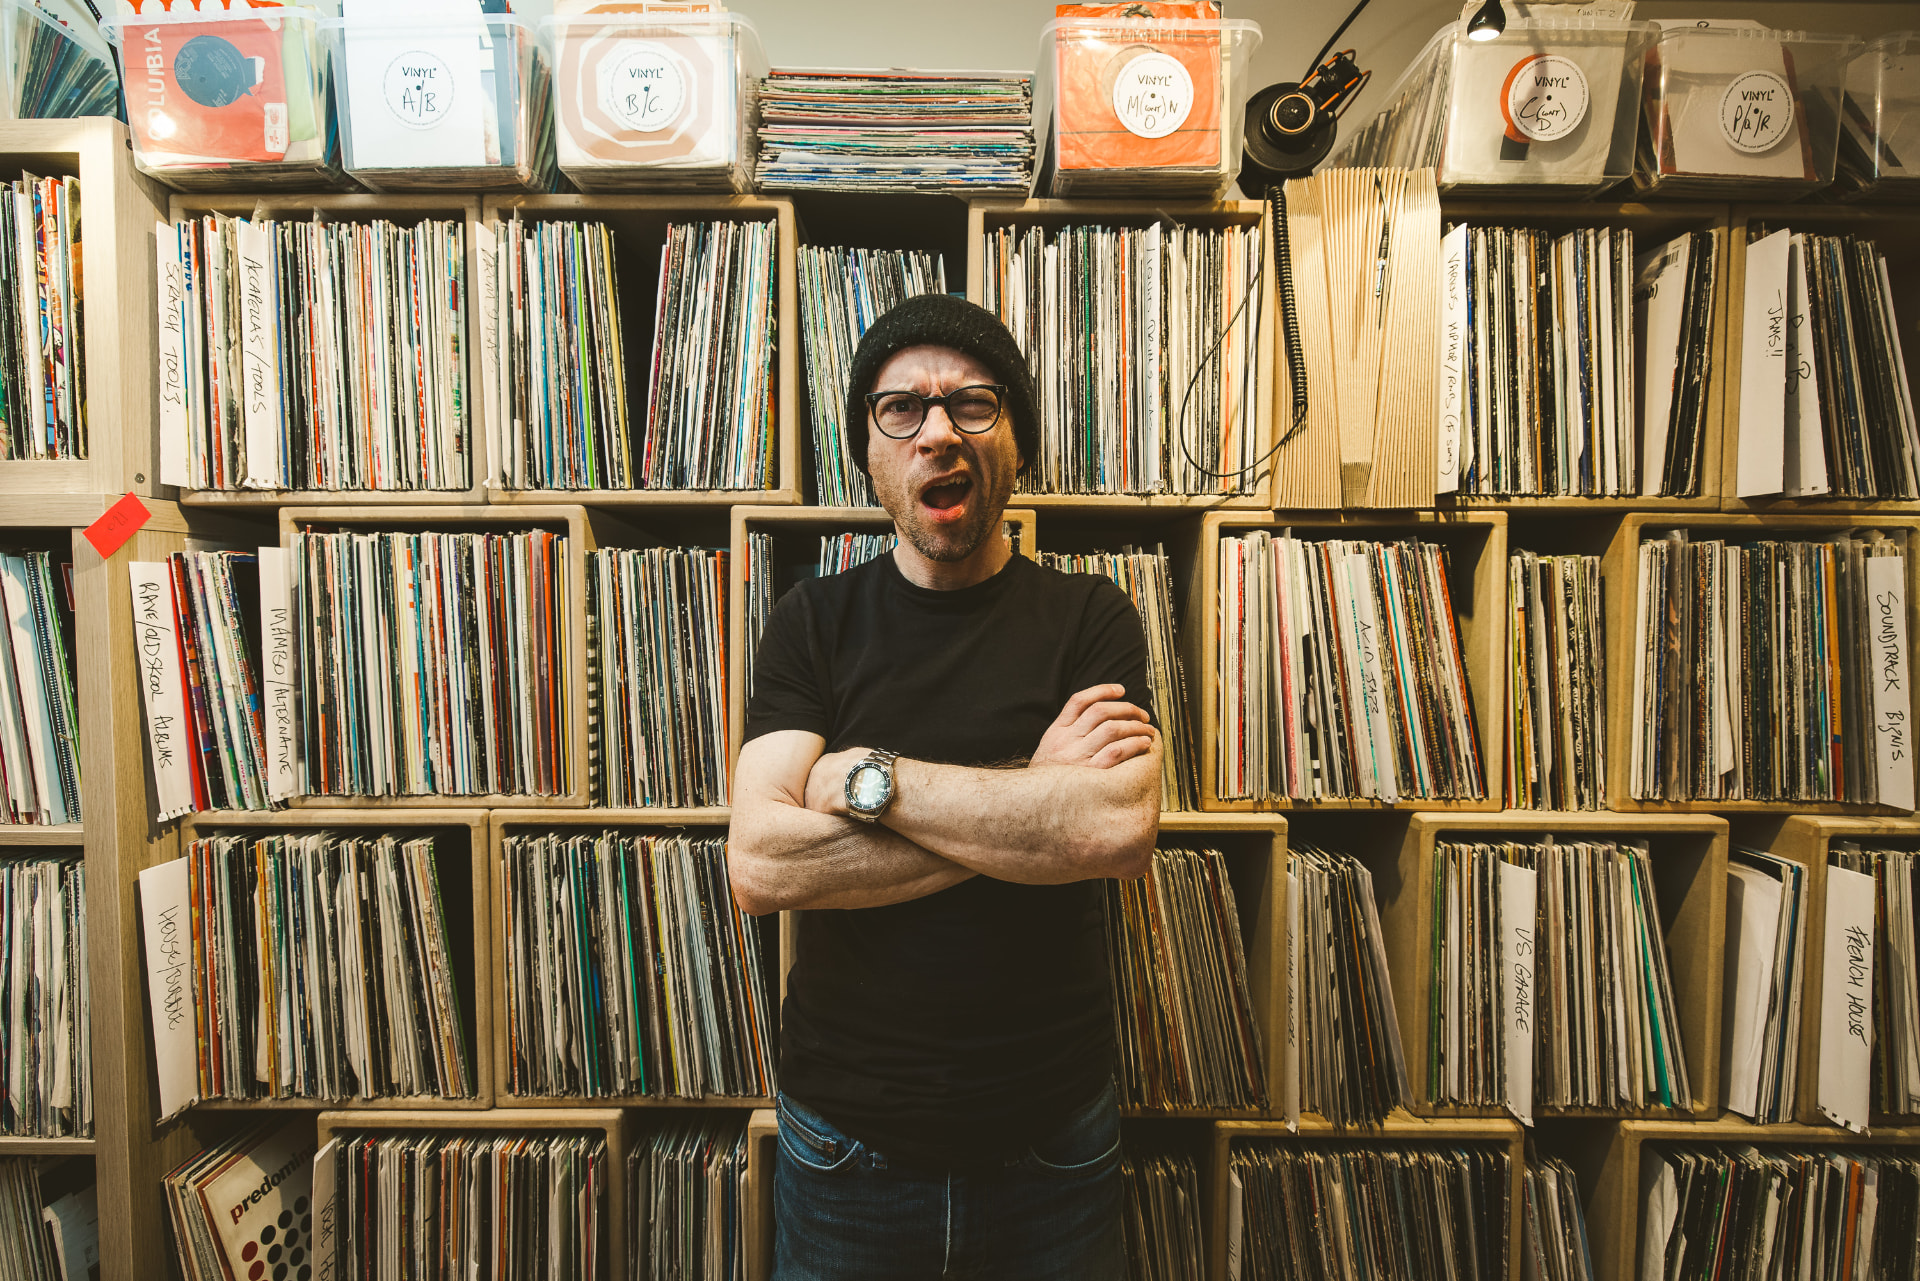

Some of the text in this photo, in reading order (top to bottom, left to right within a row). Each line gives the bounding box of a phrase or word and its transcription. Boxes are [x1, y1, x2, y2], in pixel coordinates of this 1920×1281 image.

[164, 262, 181, 333] SCRATCH
[1876, 590, 1900, 693] SOUNDTRACK
[153, 715, 174, 769] ALBUMS
[1514, 927, 1533, 957] US
[1844, 925, 1871, 1047] FRENCH HOUSE
